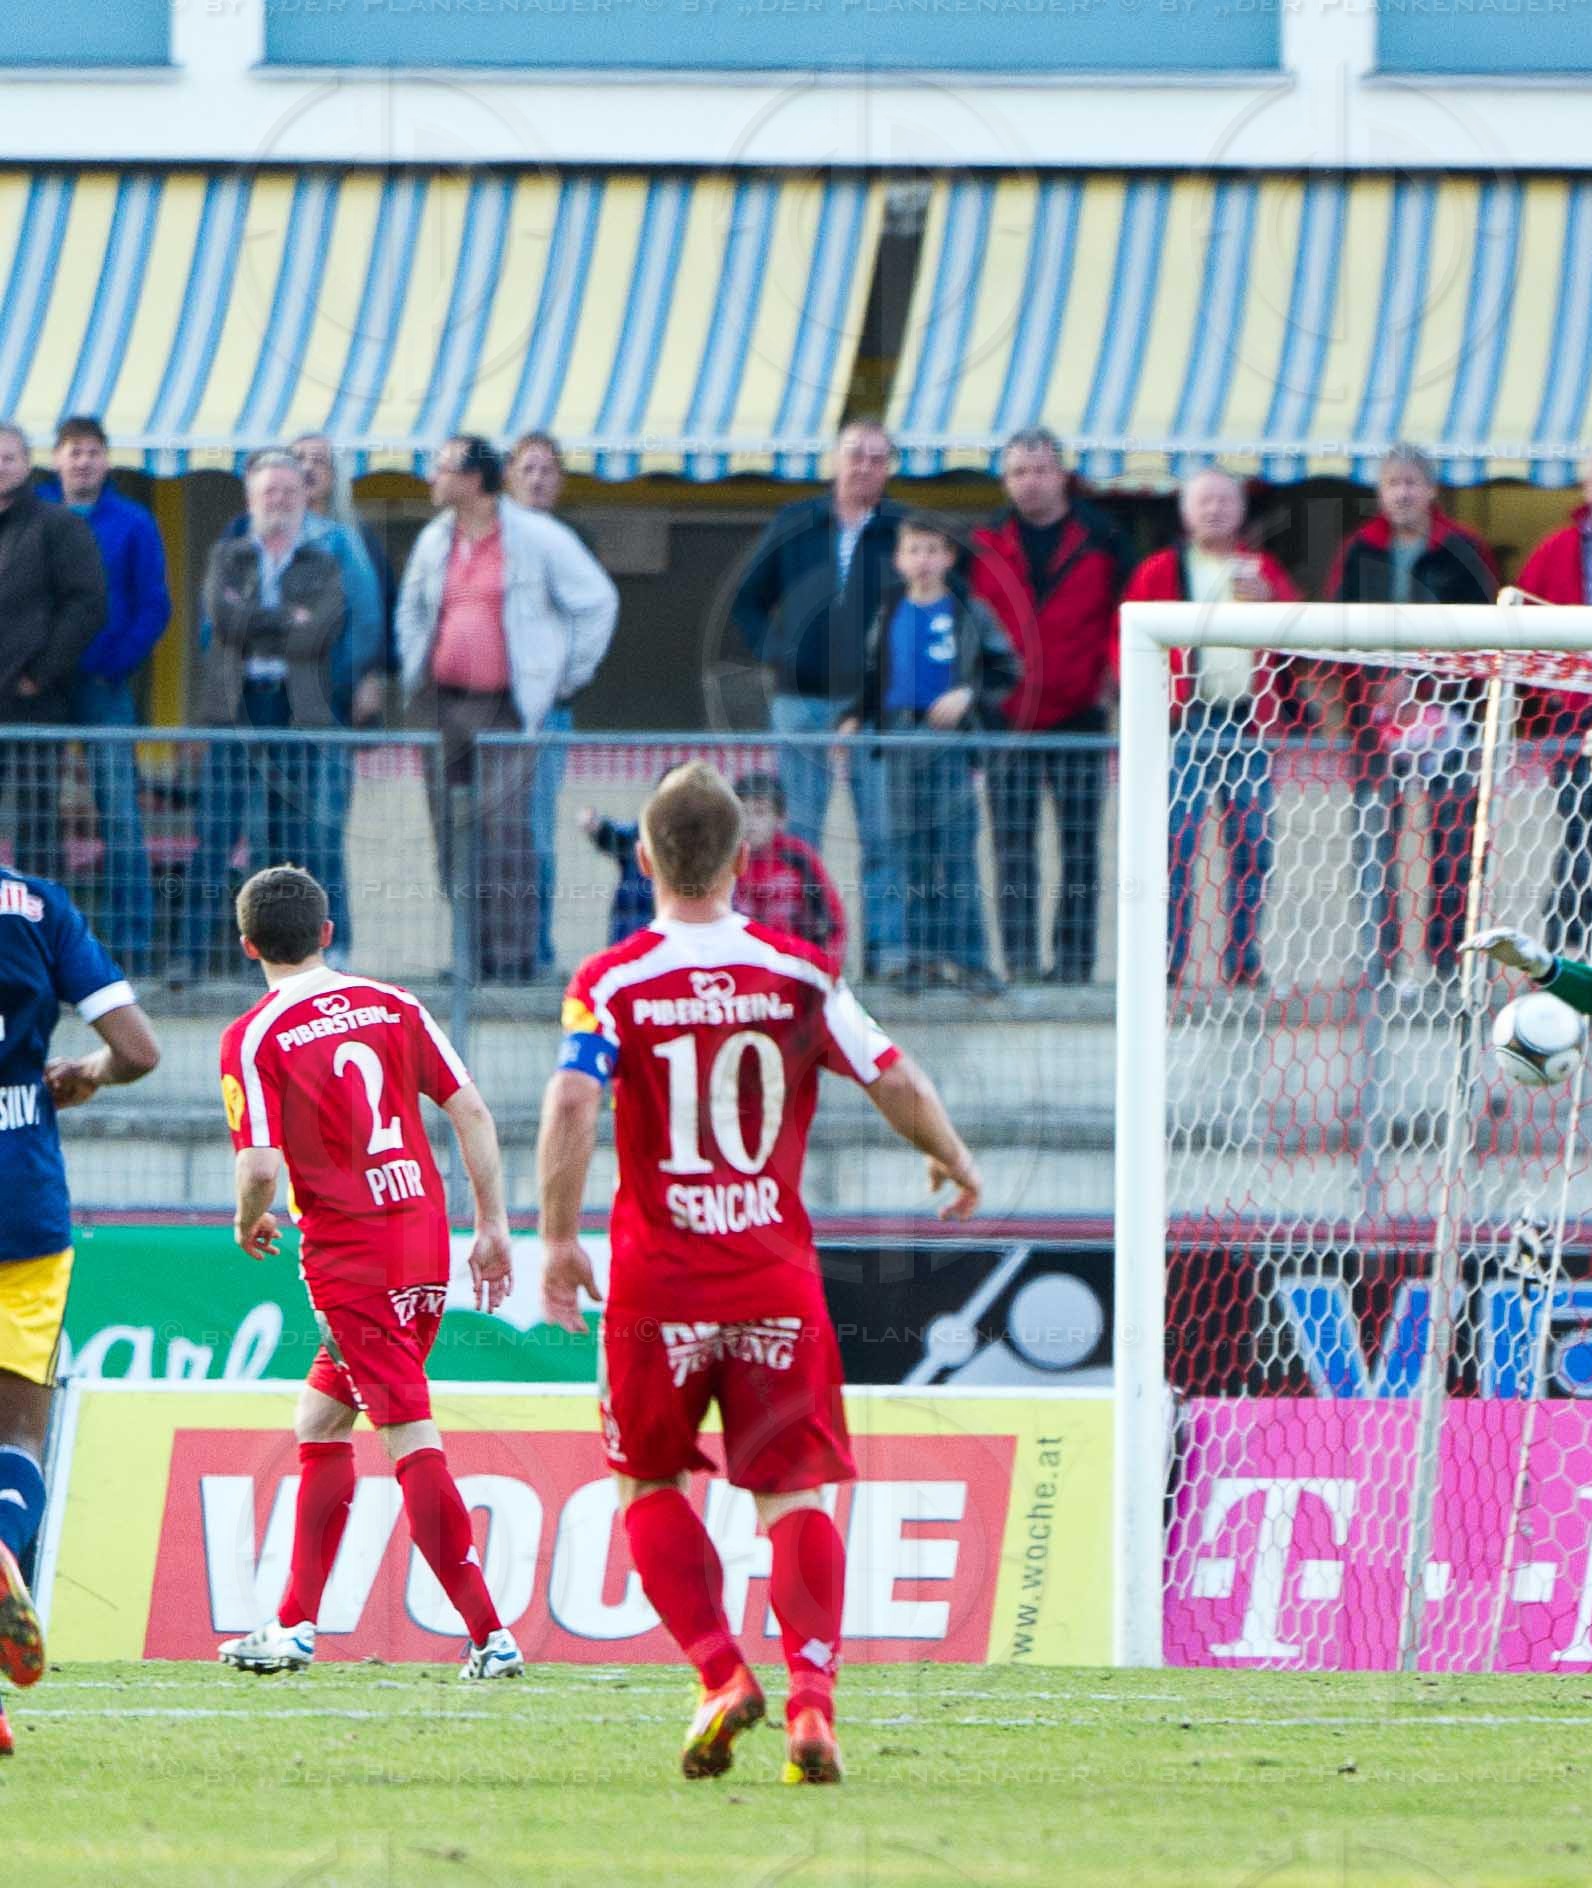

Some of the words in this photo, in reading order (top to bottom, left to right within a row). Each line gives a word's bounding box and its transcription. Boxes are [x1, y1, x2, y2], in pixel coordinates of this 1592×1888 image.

[0, 1083, 40, 1131] SILV
[333, 1040, 405, 1156] 2
[652, 1029, 787, 1176] 10
[666, 1175, 784, 1235] SENCAR
